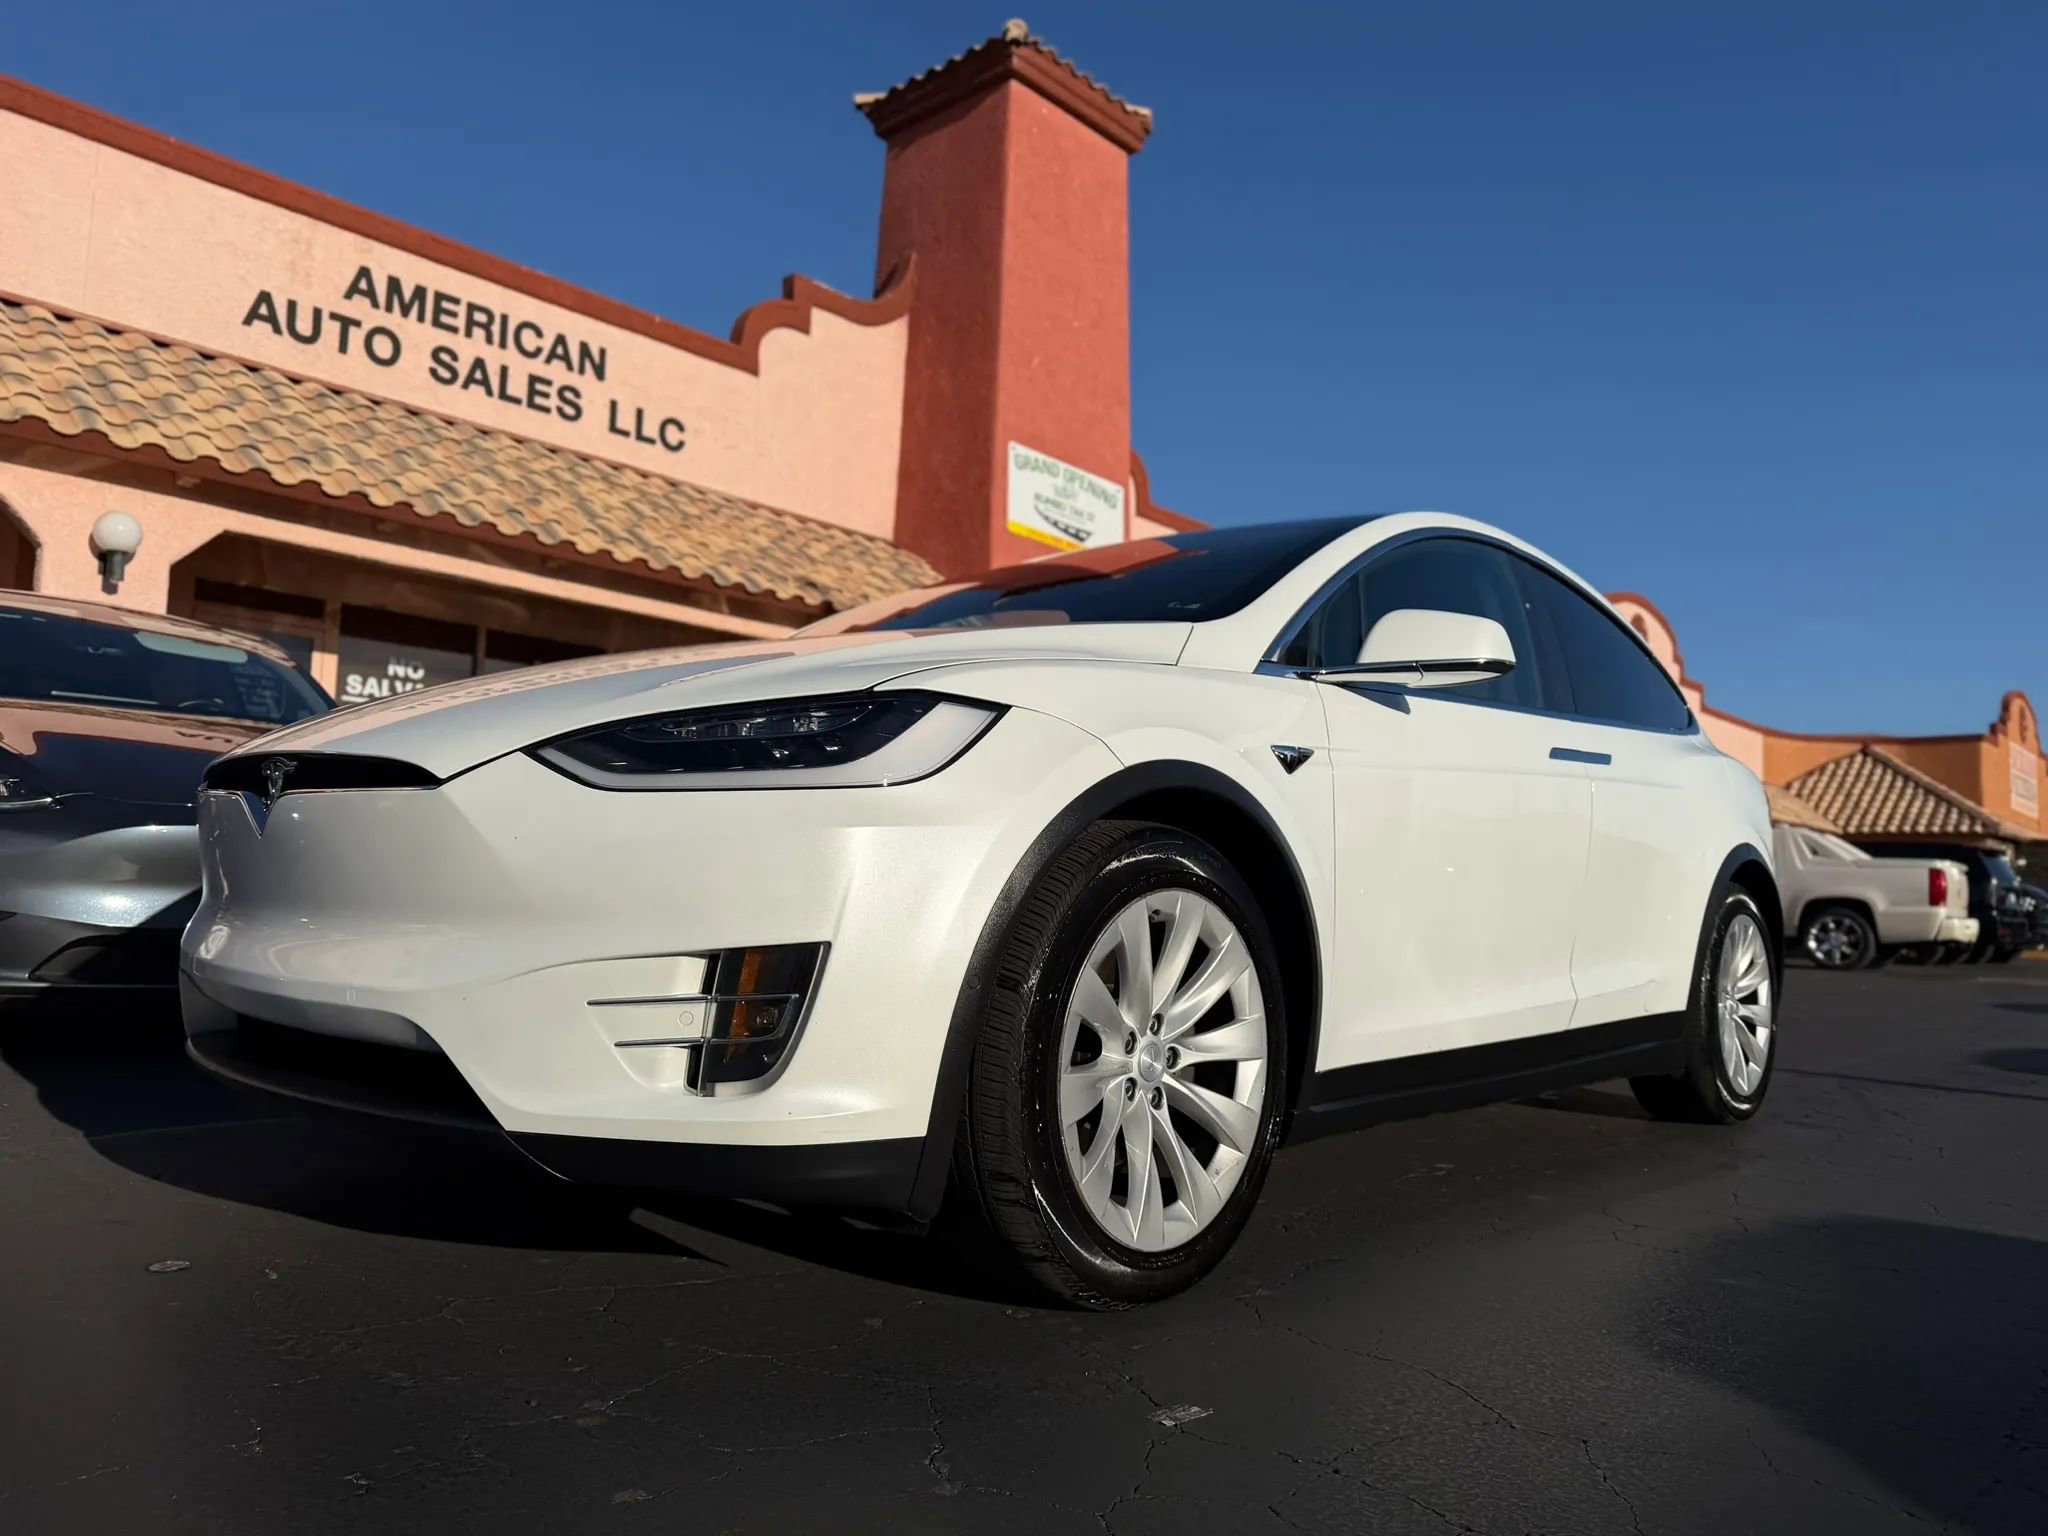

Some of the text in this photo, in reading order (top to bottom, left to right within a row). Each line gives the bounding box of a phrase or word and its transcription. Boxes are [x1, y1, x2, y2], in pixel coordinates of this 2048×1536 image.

[344, 265, 607, 381] AMERICAN
[242, 290, 686, 453] AUTO SALES LLC
[346, 673, 424, 697] SALV
[387, 658, 425, 680] NO
